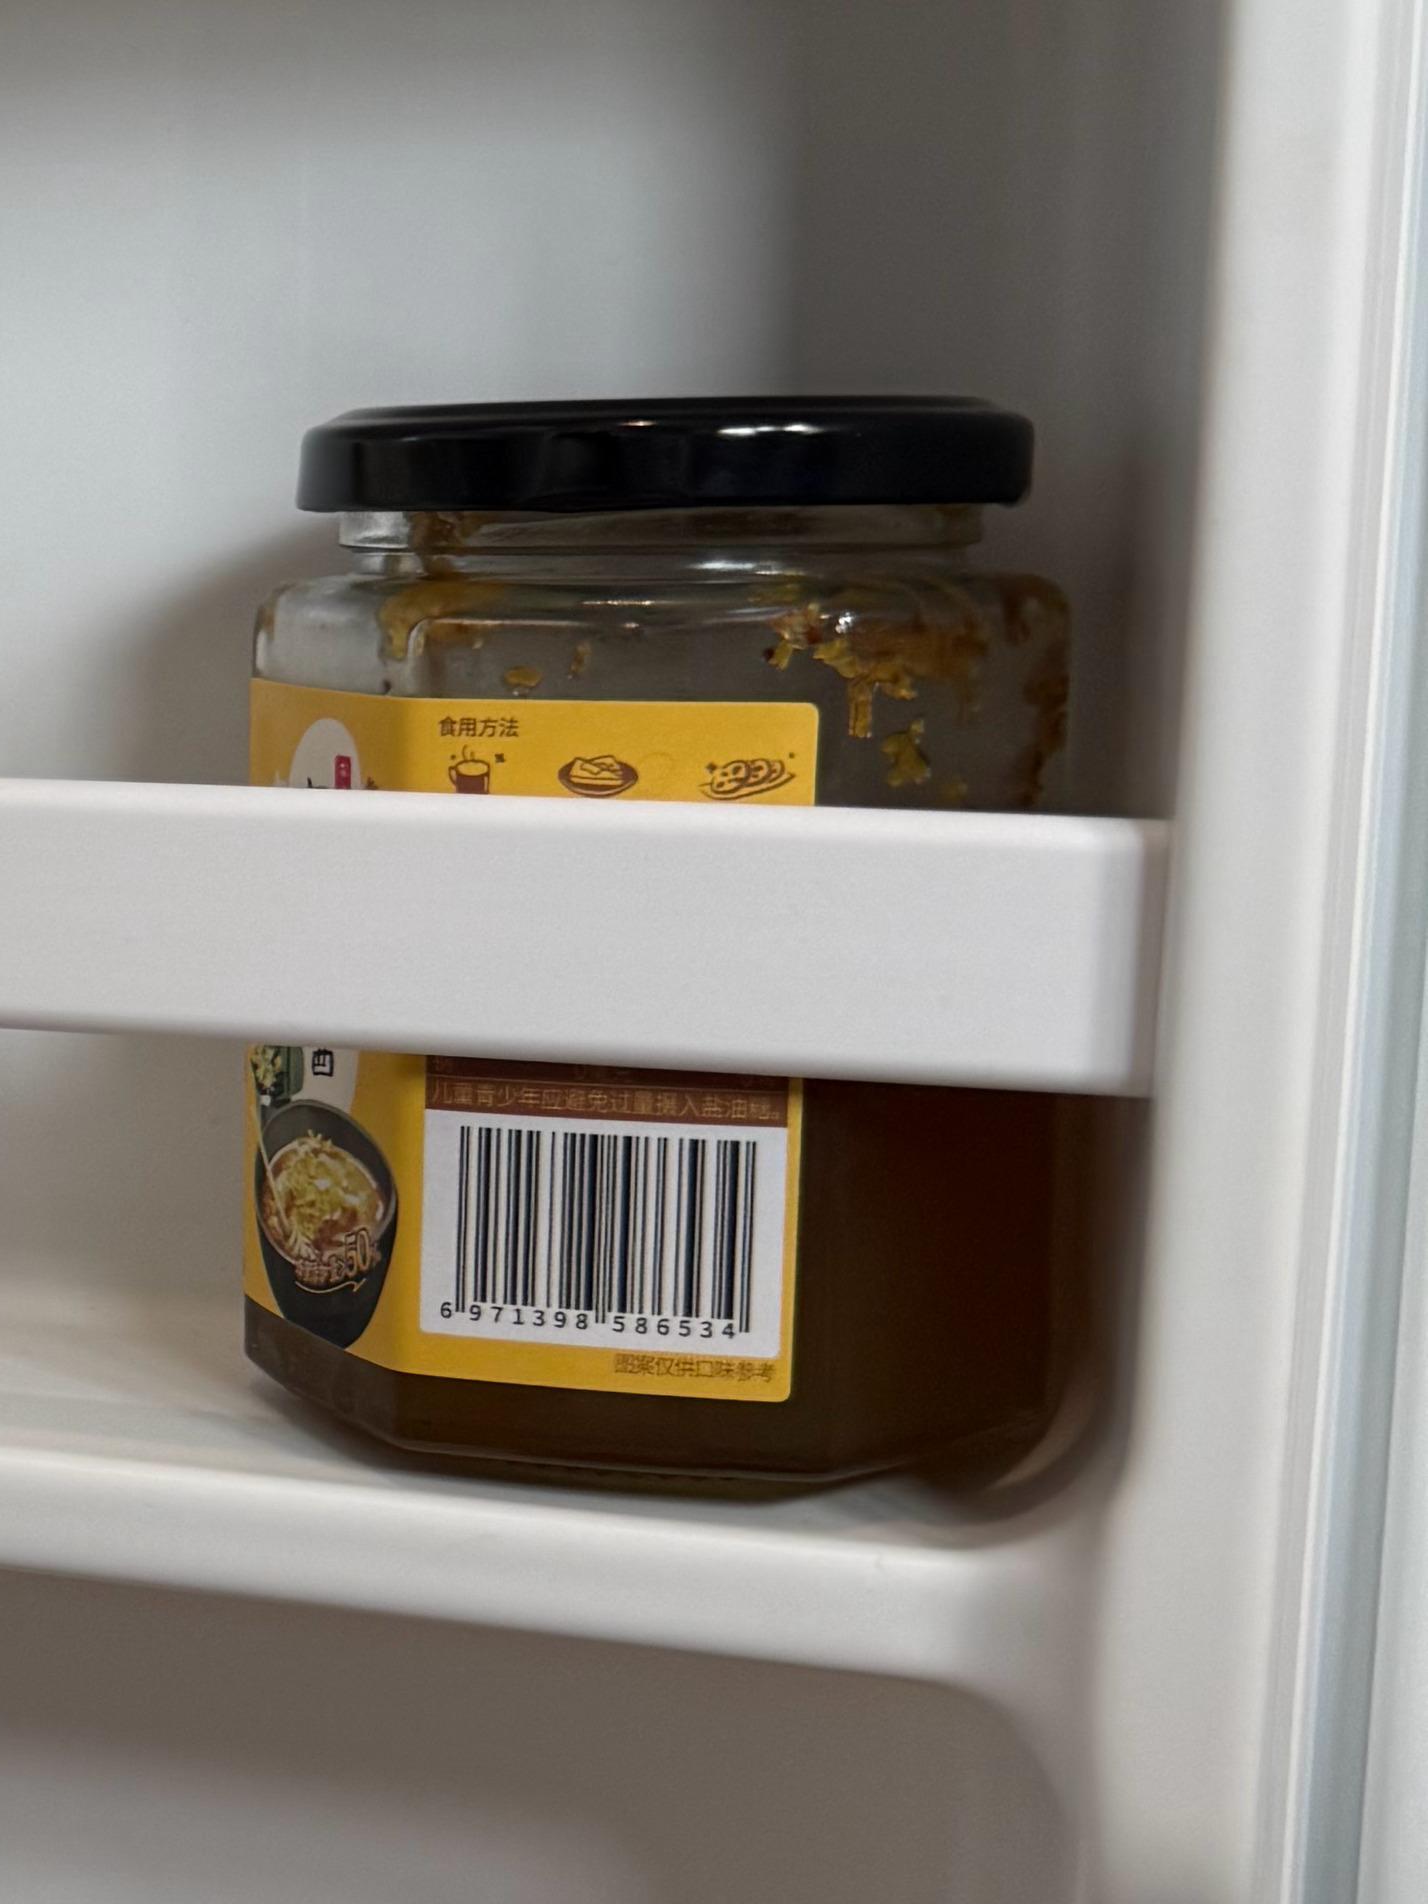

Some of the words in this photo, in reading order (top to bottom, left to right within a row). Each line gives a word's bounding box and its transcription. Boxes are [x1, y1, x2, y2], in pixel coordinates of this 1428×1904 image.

[439, 716, 519, 738] 食用方法
[440, 1301, 452, 1319] 6
[470, 1305, 588, 1330] 971398
[612, 1316, 736, 1339] 586534
